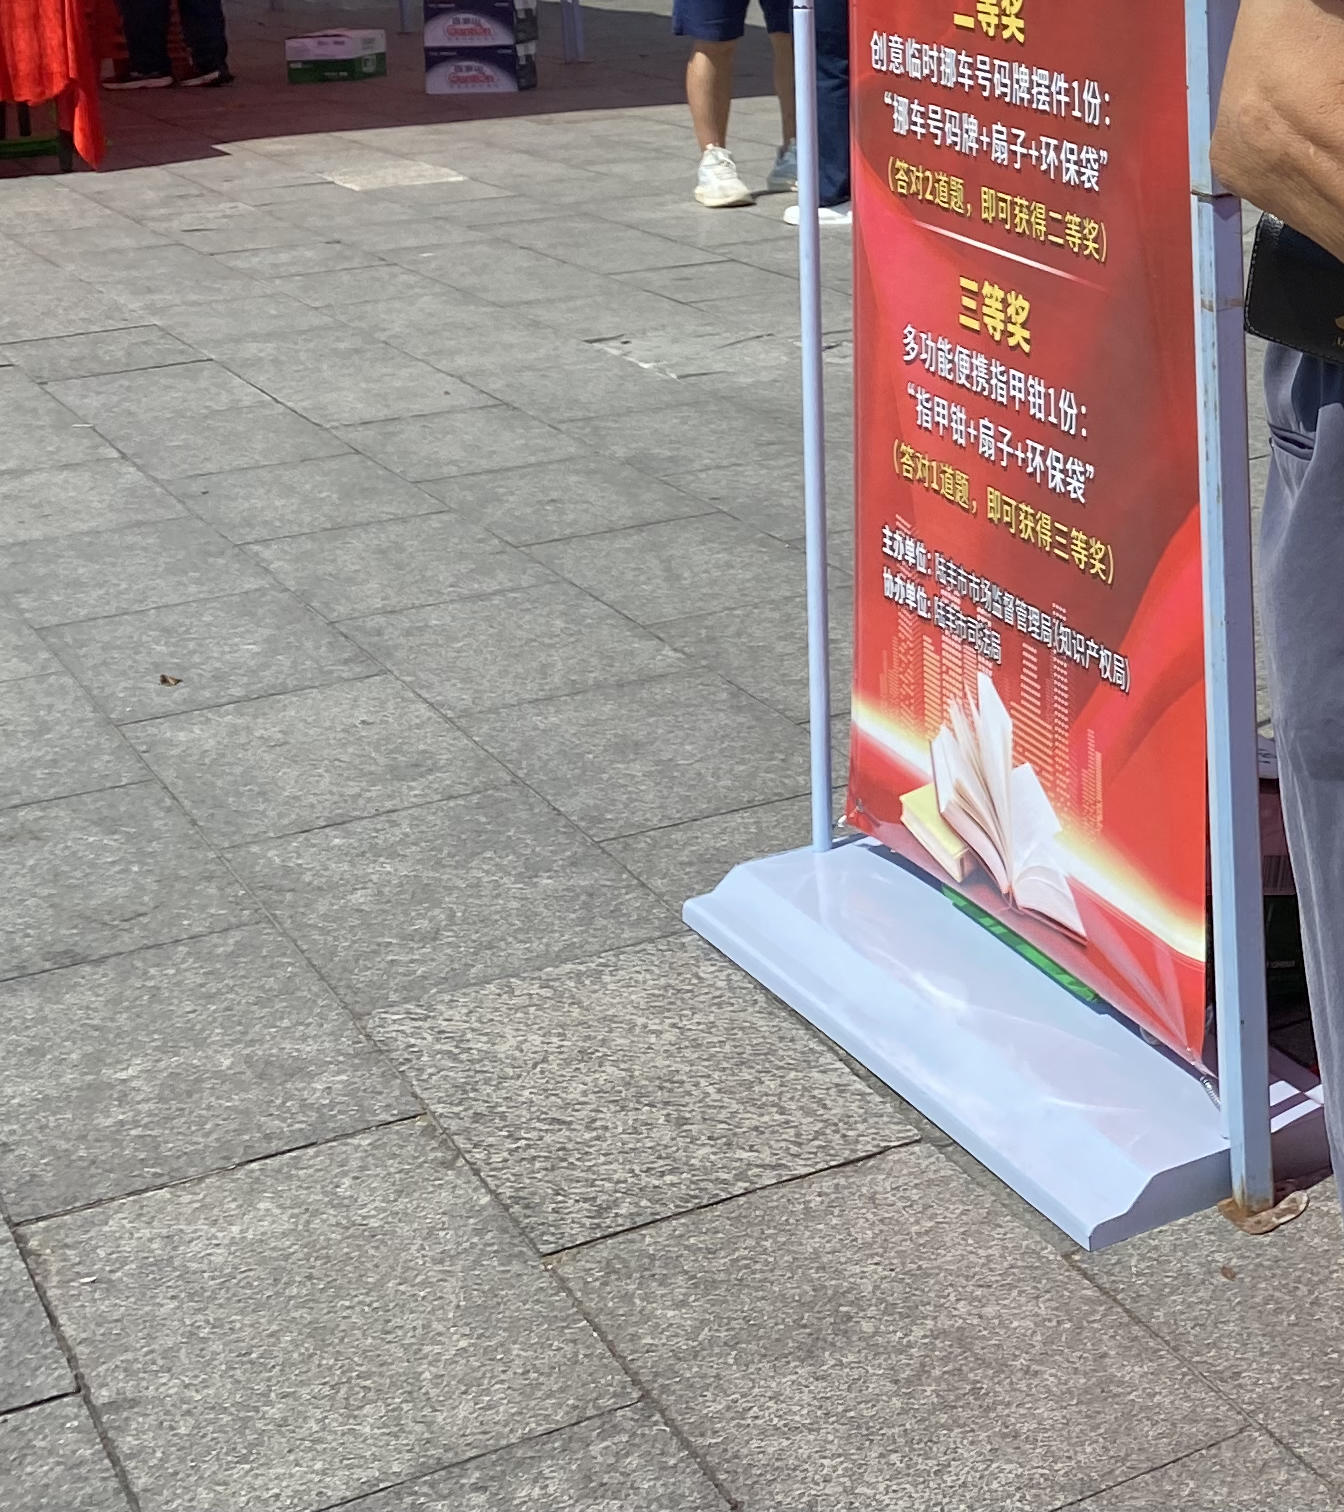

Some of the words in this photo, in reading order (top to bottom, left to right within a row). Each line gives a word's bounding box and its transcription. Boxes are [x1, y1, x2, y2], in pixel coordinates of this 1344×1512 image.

[870, 30, 1111, 126] 创意临时挪车号码牌摆件1份：
[884, 90, 1108, 191] “挪车号码牌+扇子+环保袋”
[887, 158, 1107, 262] （答对2道题，即可获得二等奖）
[958, 275, 1031, 353] 三等奖
[901, 324, 1088, 437] 多功能便携指甲钳1份：
[907, 382, 1095, 504] “指甲钳+扇子+环保袋”
[892, 439, 1114, 585] （答对1道题，即可获得三等奖）
